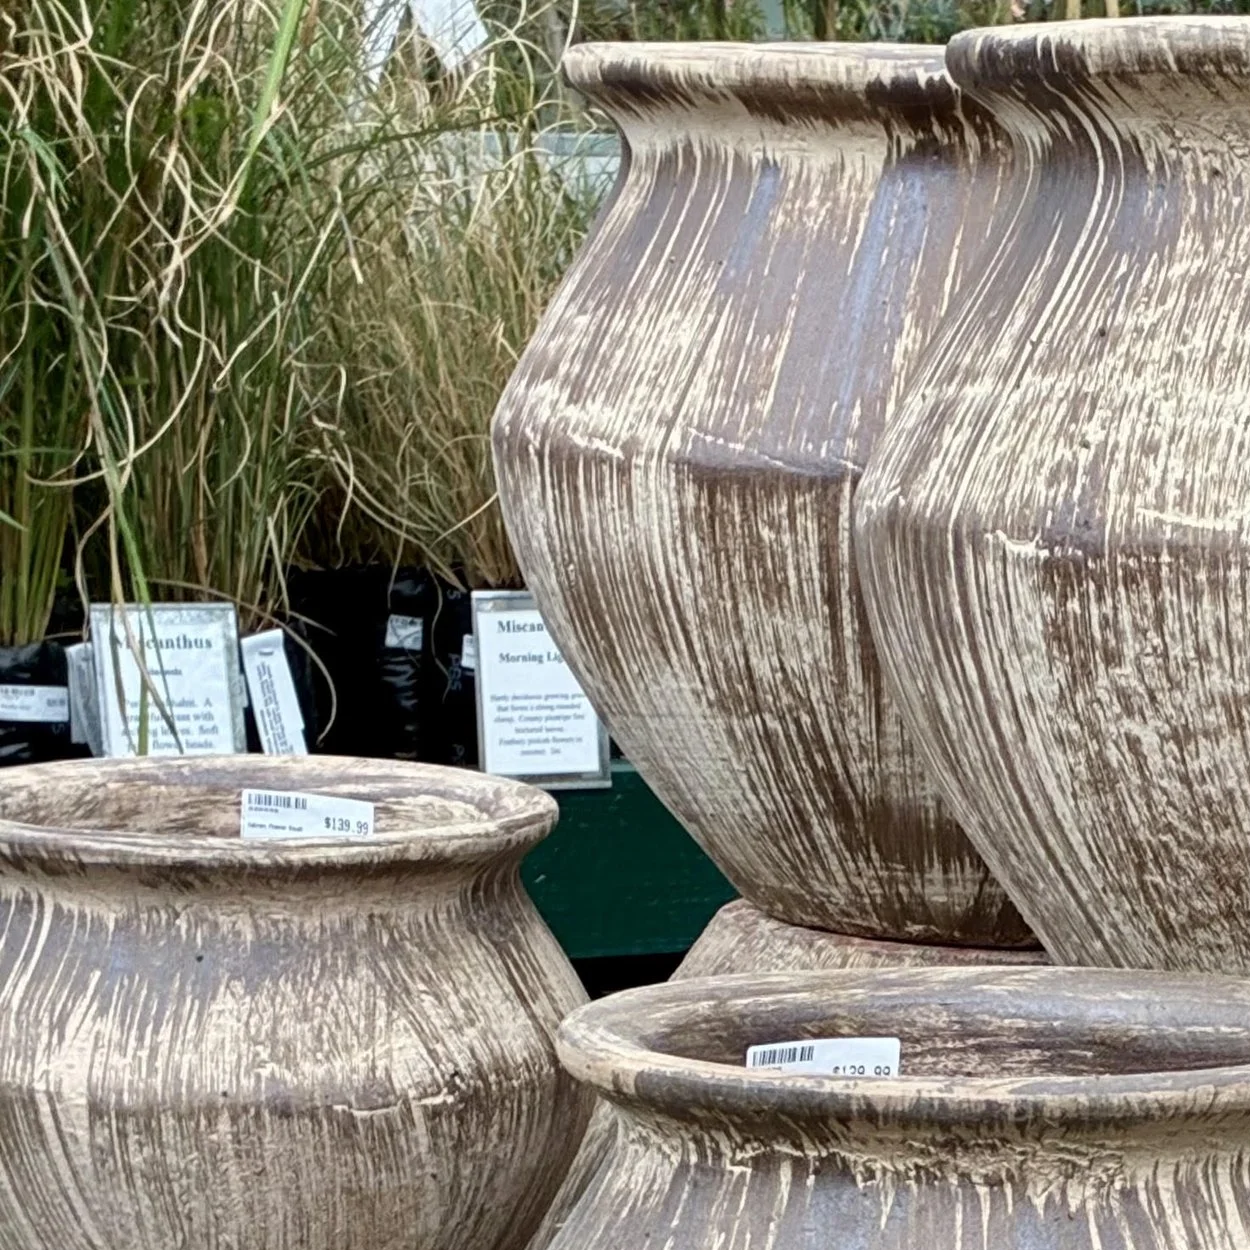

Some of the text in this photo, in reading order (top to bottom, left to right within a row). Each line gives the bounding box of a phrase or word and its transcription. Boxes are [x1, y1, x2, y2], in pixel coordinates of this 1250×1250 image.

[497, 620, 544, 634] Miscan
[499, 651, 564, 664] Morning Lig
[324, 816, 368, 836] $139.99
